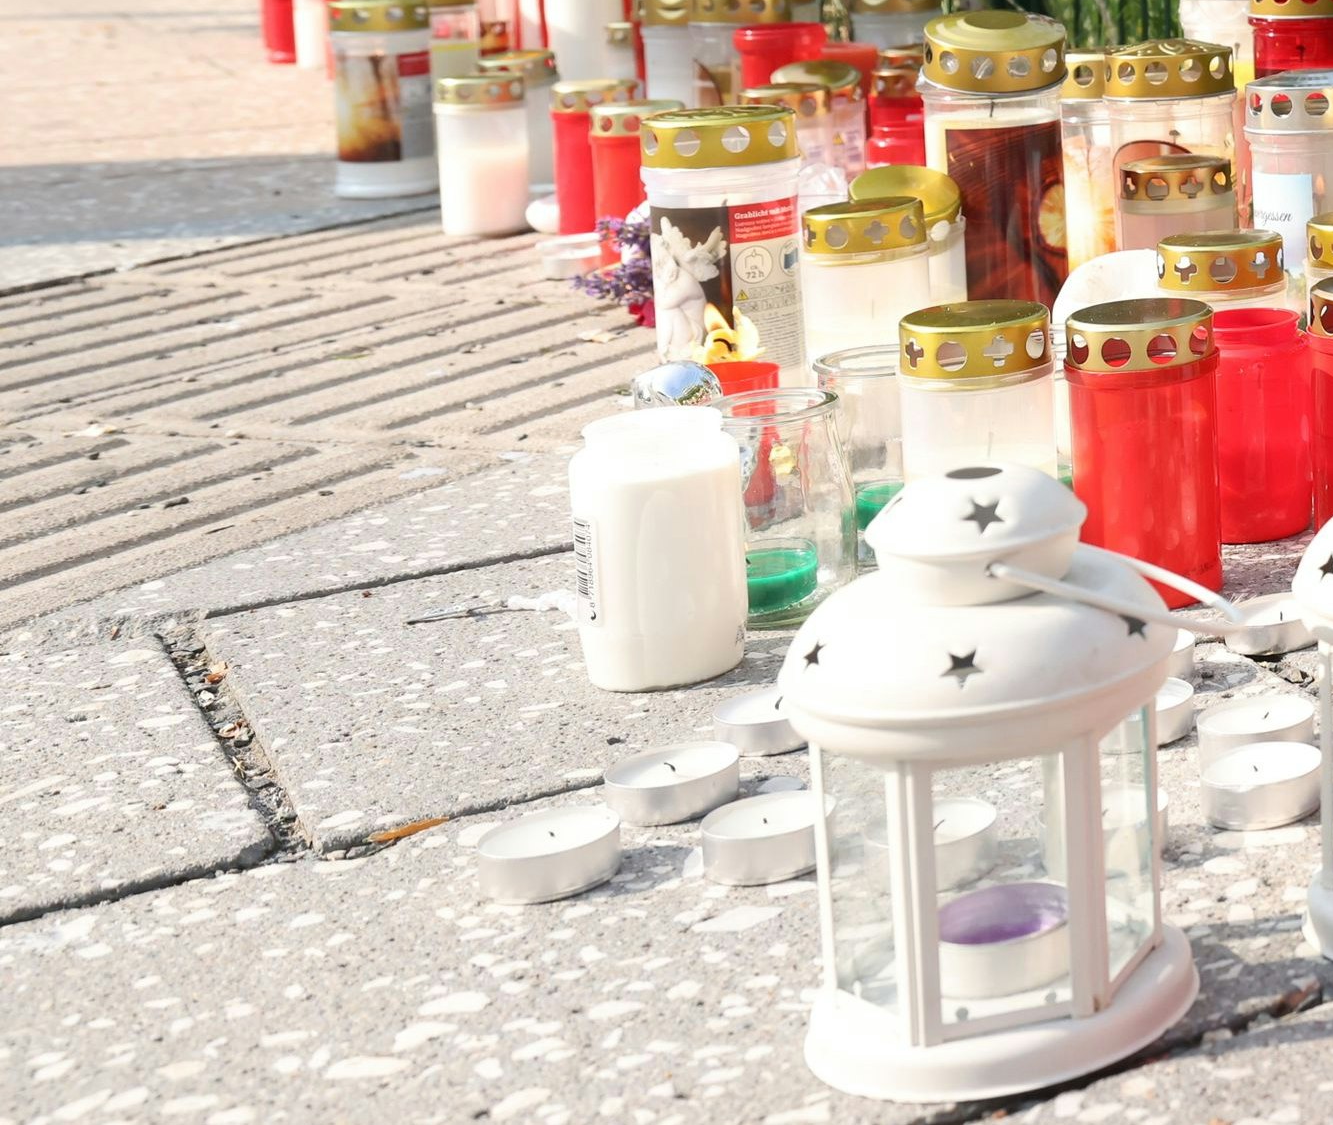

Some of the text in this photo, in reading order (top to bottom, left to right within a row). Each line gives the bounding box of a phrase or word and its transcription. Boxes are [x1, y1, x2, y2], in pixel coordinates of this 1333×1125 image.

[735, 211, 769, 219] Grablicht
[745, 270, 765, 279] 72 h
